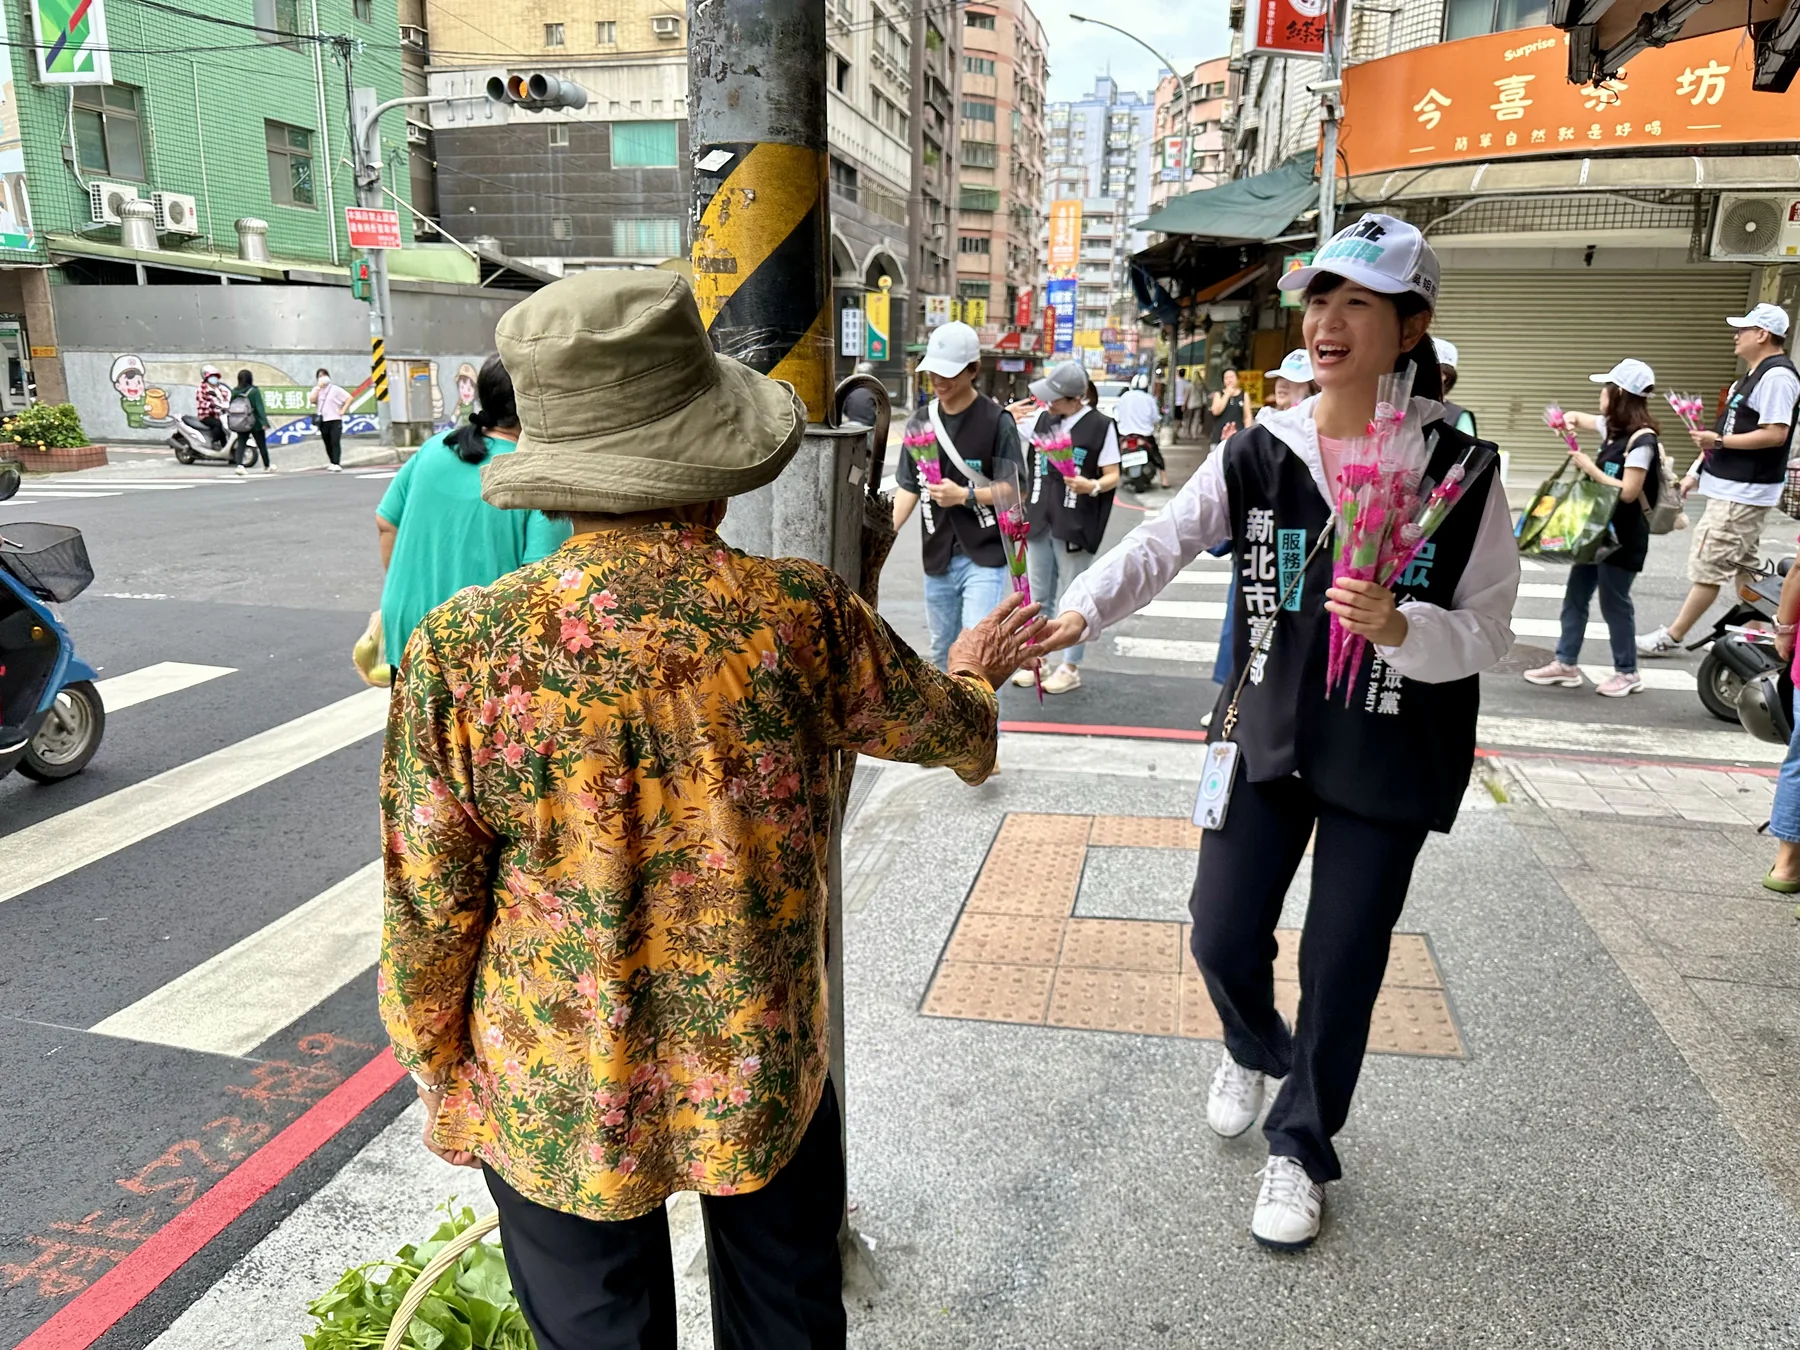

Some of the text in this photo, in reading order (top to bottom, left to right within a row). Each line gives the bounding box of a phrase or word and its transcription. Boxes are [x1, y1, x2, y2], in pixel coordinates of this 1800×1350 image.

[1504, 37, 1556, 61] Surprise
[1412, 60, 1731, 130] 今喜茶坊
[1454, 120, 1662, 152] 簡單自然就是好喝
[1242, 507, 1277, 686] 新北市黨部
[1364, 682, 1379, 713] PARTY
